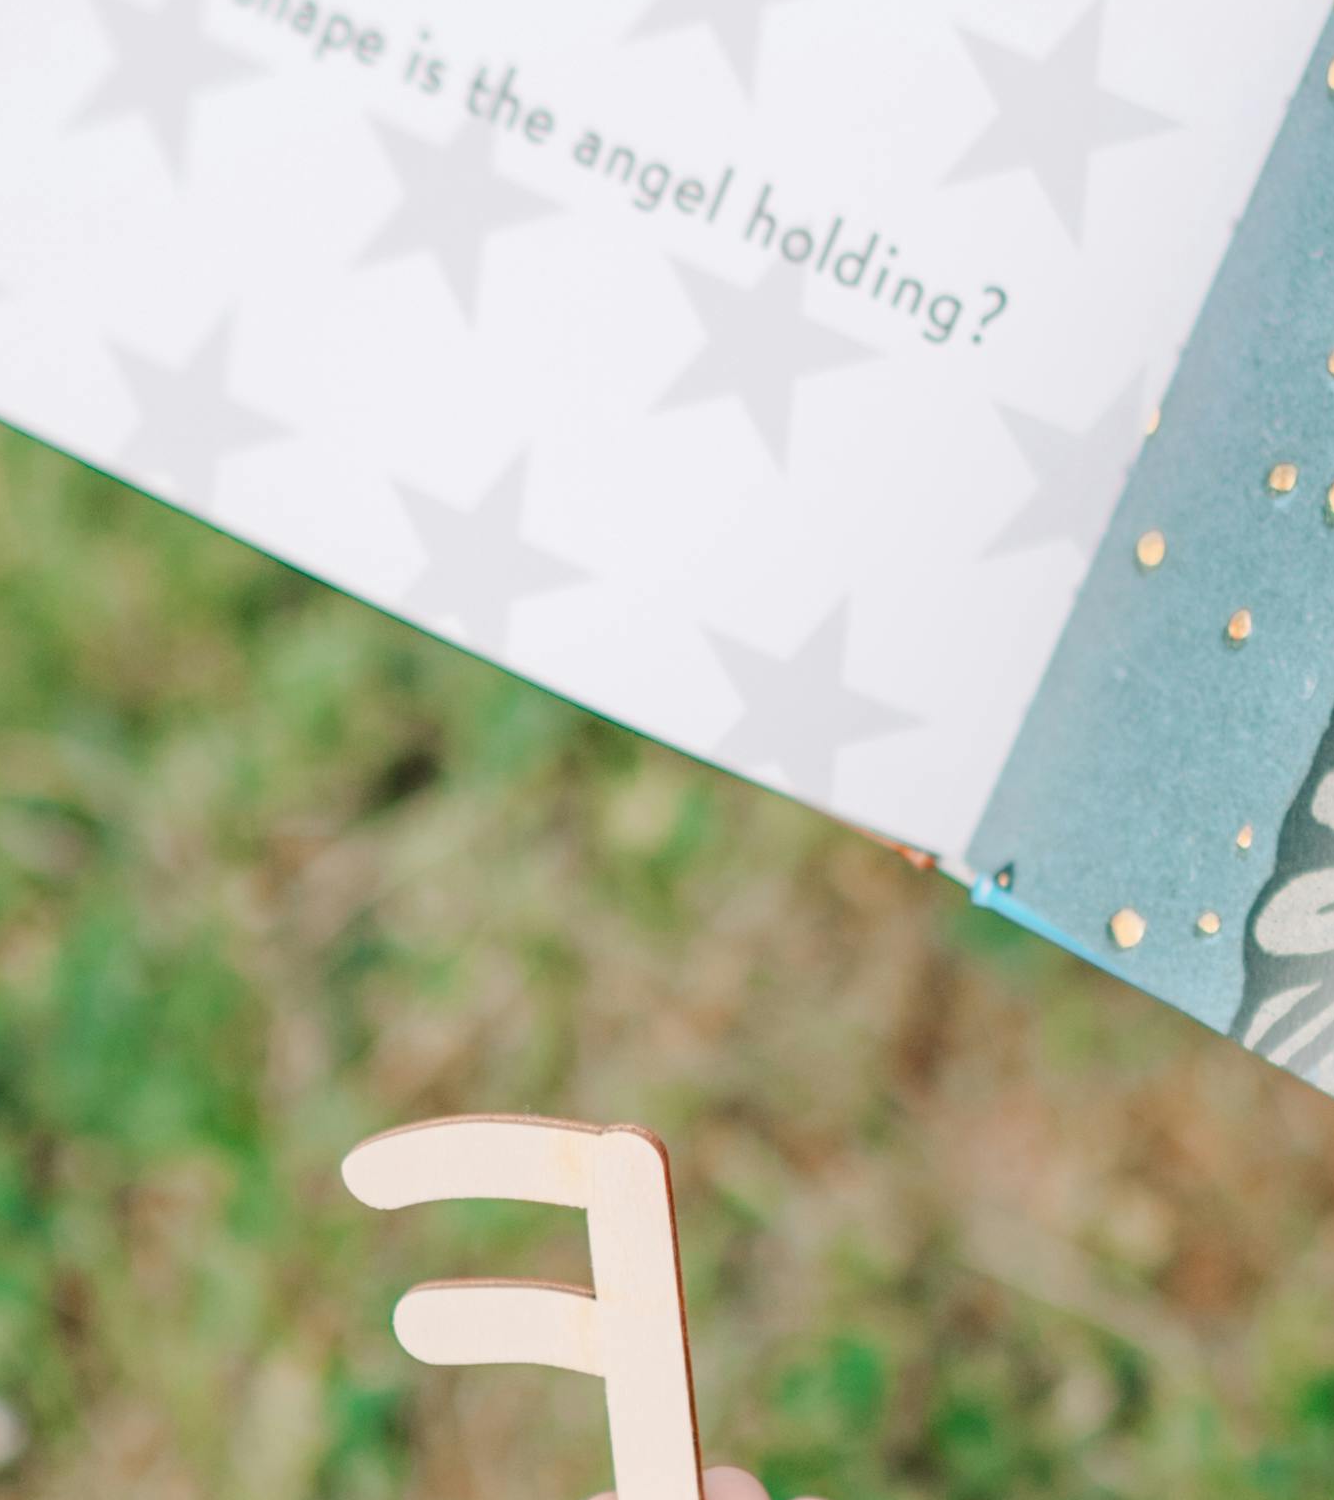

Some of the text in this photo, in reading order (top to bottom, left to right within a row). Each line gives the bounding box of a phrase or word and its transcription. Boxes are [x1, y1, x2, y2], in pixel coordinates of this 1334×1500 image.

[404, 28, 447, 94] is
[466, 66, 555, 145] the
[572, 131, 734, 223] angel
[743, 184, 1008, 345] holding?
